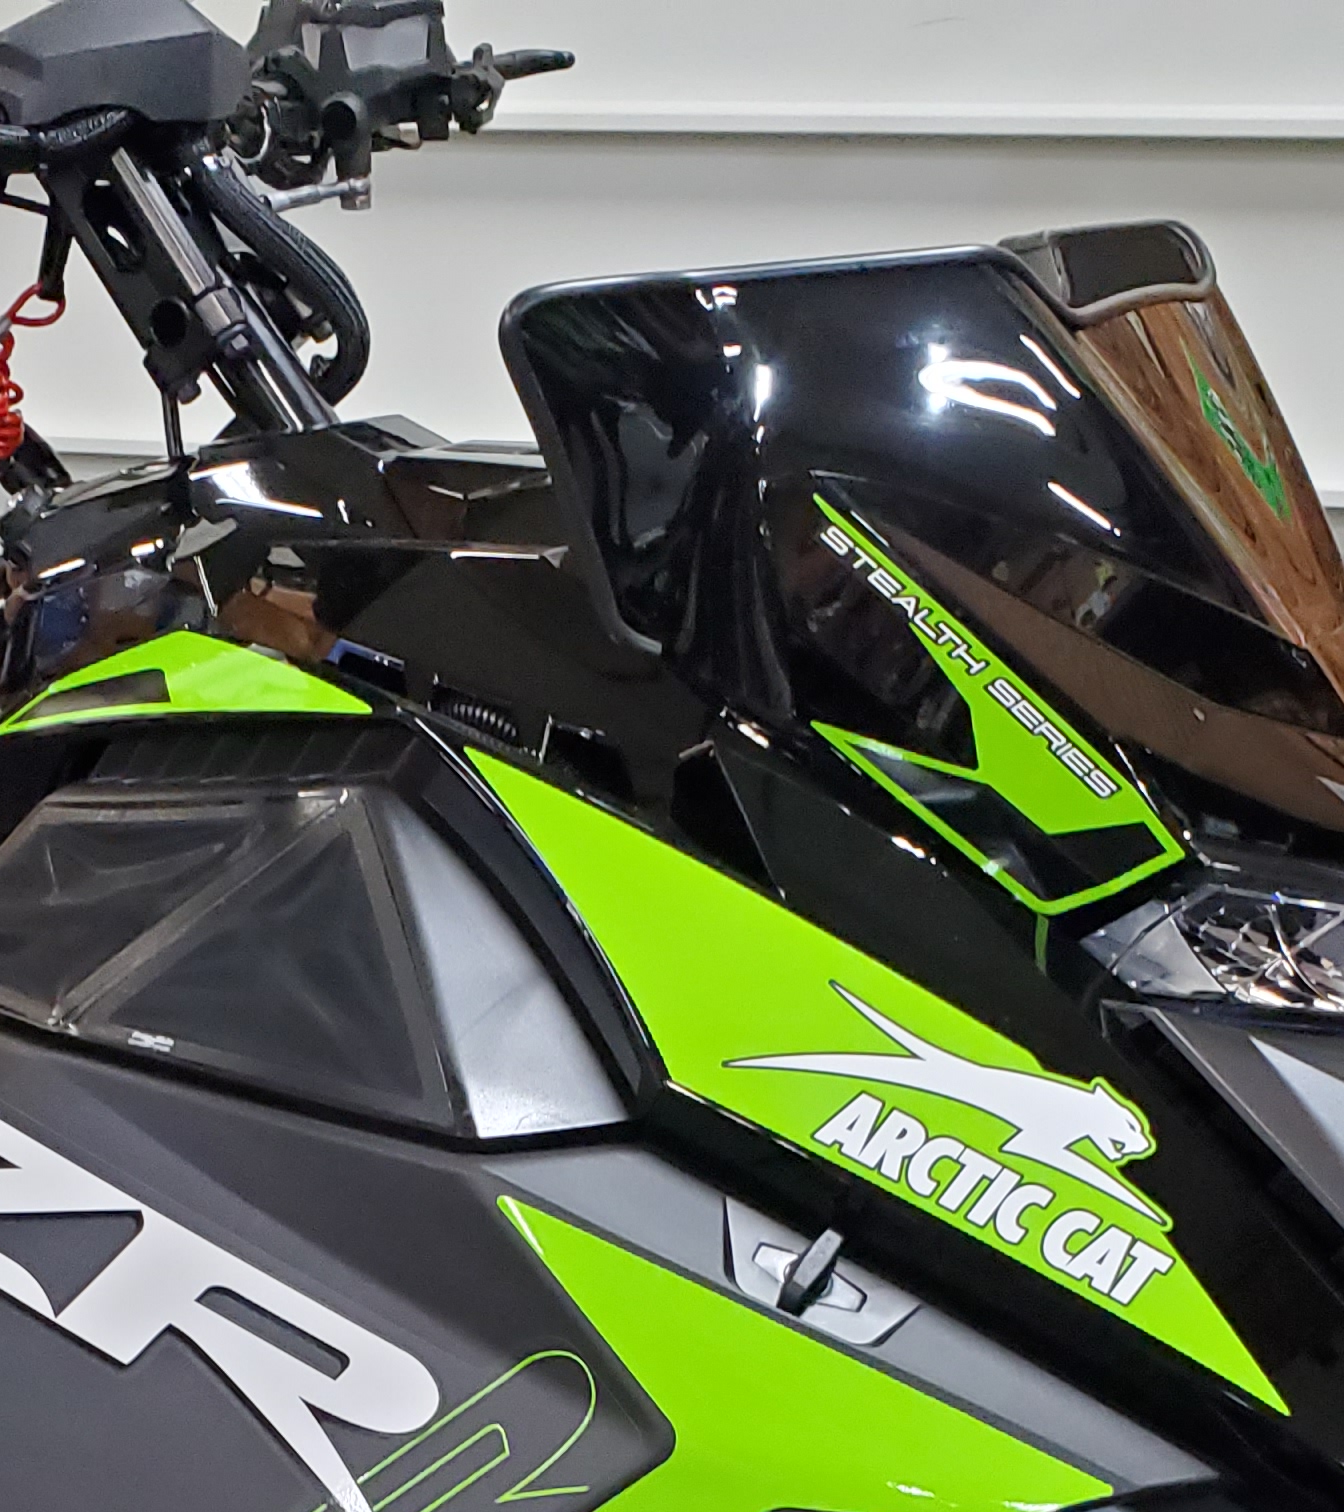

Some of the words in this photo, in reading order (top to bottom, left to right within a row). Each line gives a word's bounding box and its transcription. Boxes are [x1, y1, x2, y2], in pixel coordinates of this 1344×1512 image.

[820, 524, 990, 675] STEALTH
[984, 678, 1122, 800] SERIES
[813, 1092, 1054, 1246] ARCTIC
[1039, 1208, 1174, 1306] CAT
